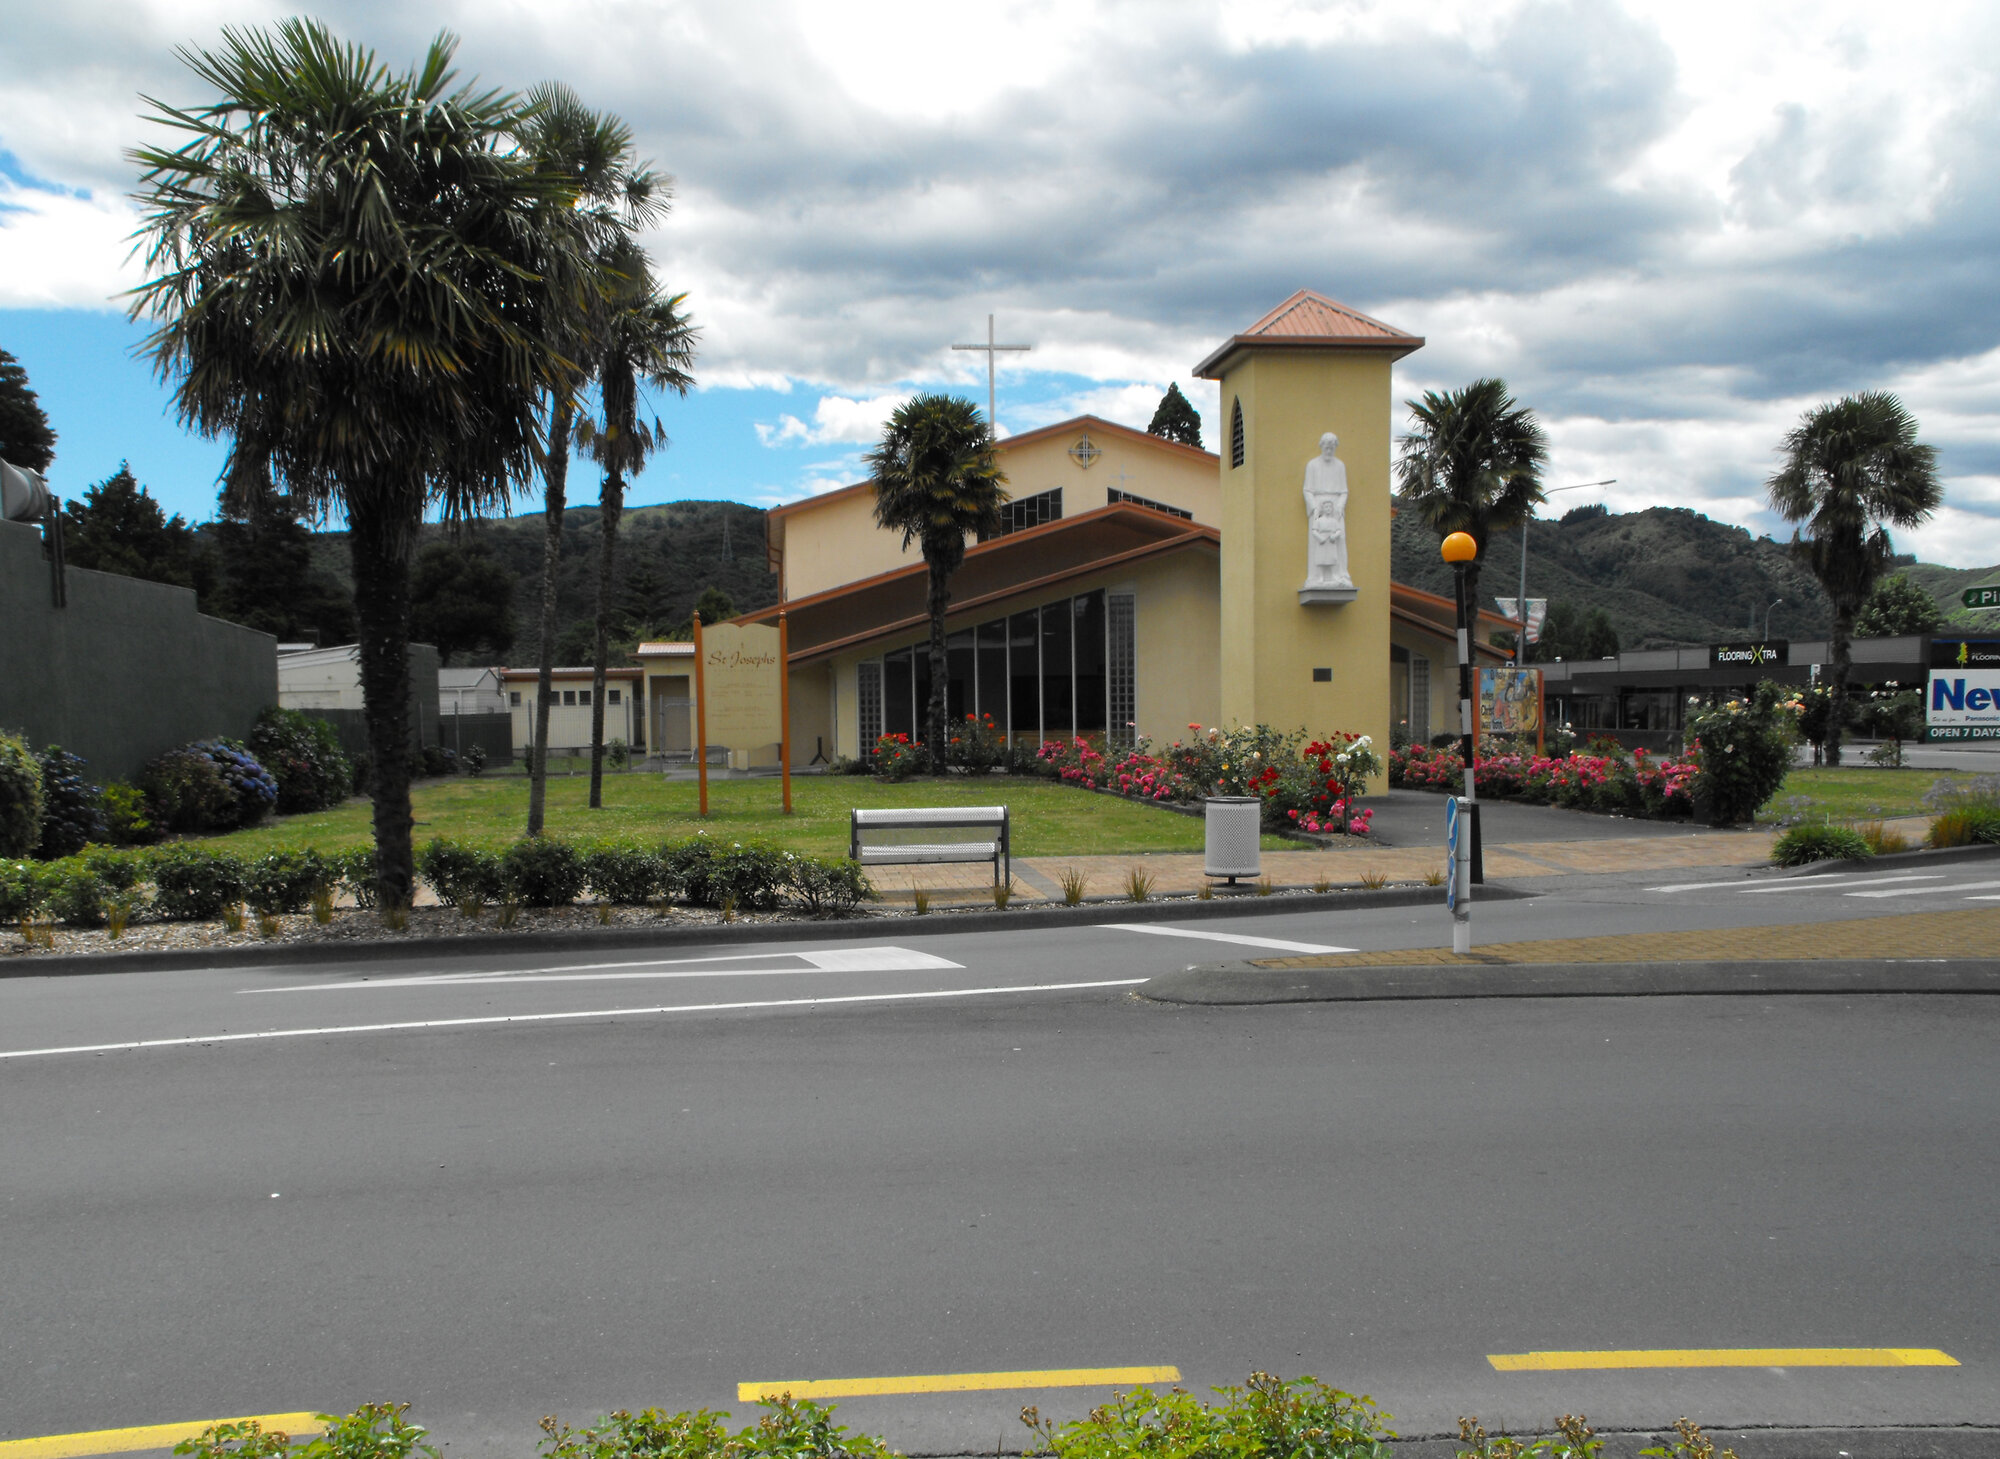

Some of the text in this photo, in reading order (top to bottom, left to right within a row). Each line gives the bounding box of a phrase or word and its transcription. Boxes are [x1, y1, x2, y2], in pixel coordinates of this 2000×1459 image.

[1981, 590, 2000, 604] Pi
[708, 650, 776, 669] St Josephs
[1930, 728, 1960, 737] OPEN
[1963, 728, 1970, 737] 7
